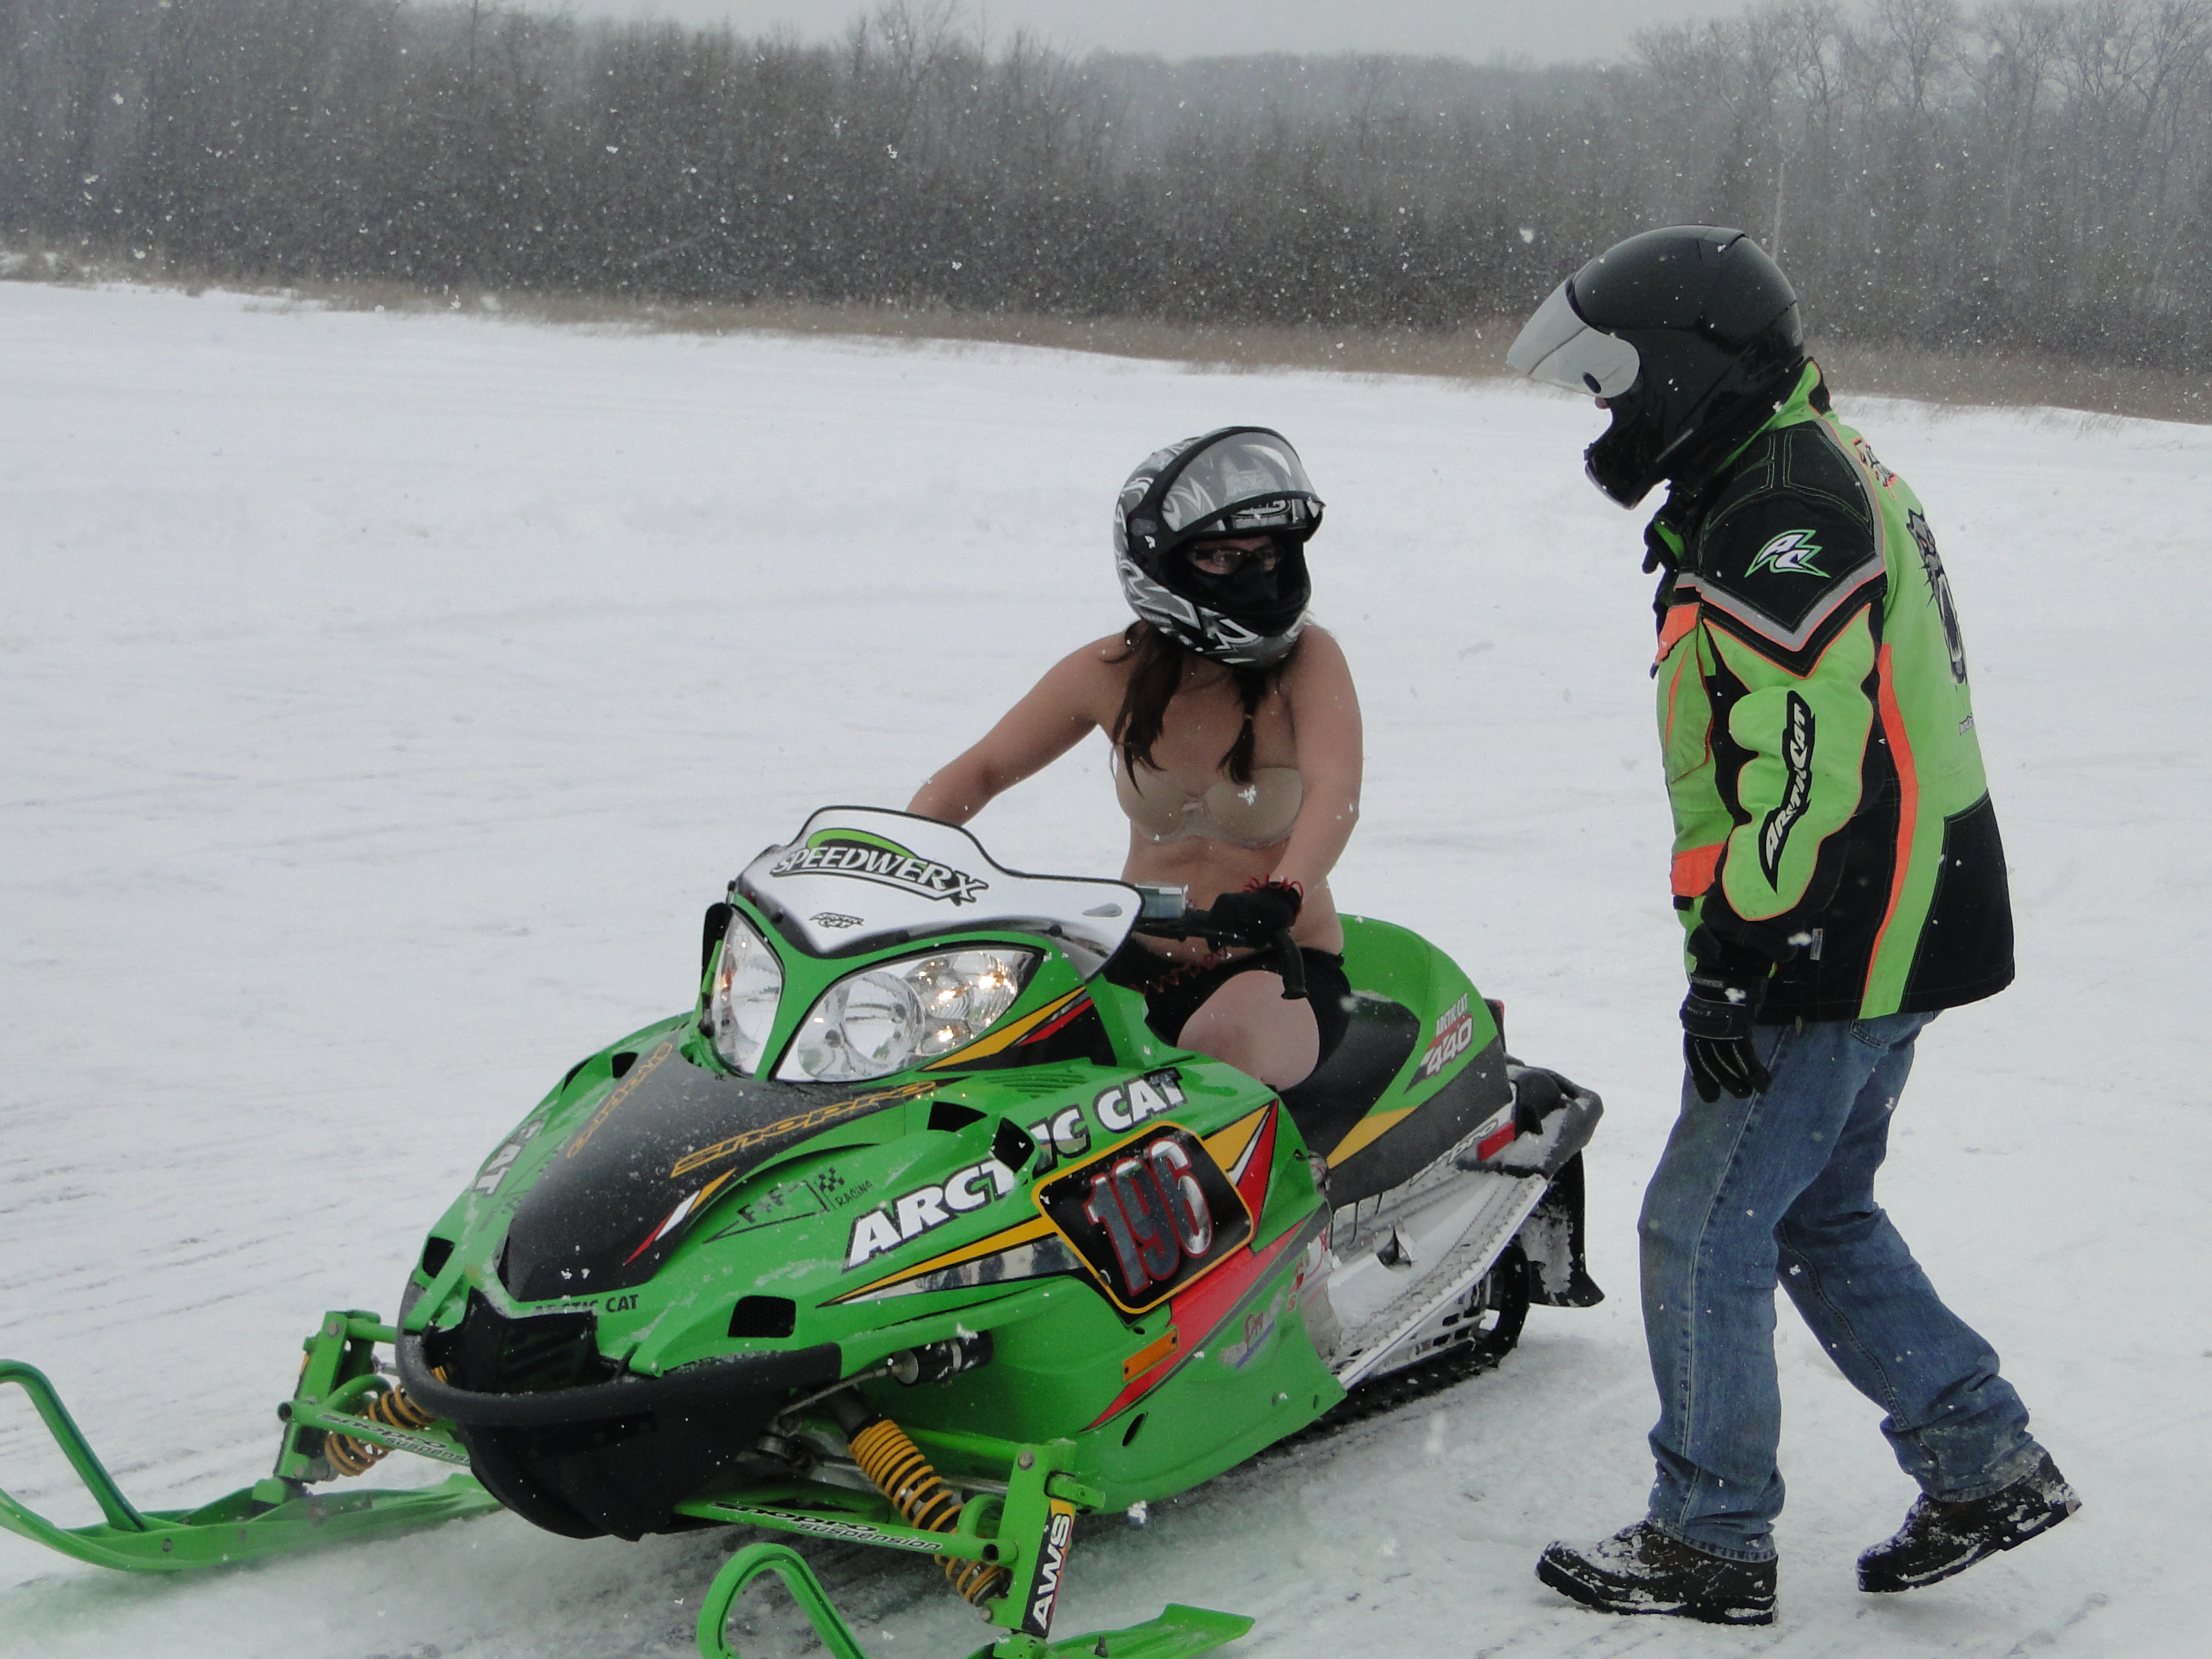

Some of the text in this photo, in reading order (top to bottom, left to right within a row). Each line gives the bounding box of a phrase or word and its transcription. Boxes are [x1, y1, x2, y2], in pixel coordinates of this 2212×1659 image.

[770, 845, 989, 906] SPEEDWERX
[1425, 1016, 1473, 1078] 440
[1093, 1067, 1190, 1134] CAT
[1083, 1137, 1214, 1297] 196
[605, 1294, 639, 1313] CAT
[796, 1521, 943, 1551] suspension
[1032, 1514, 1071, 1631] AWS
